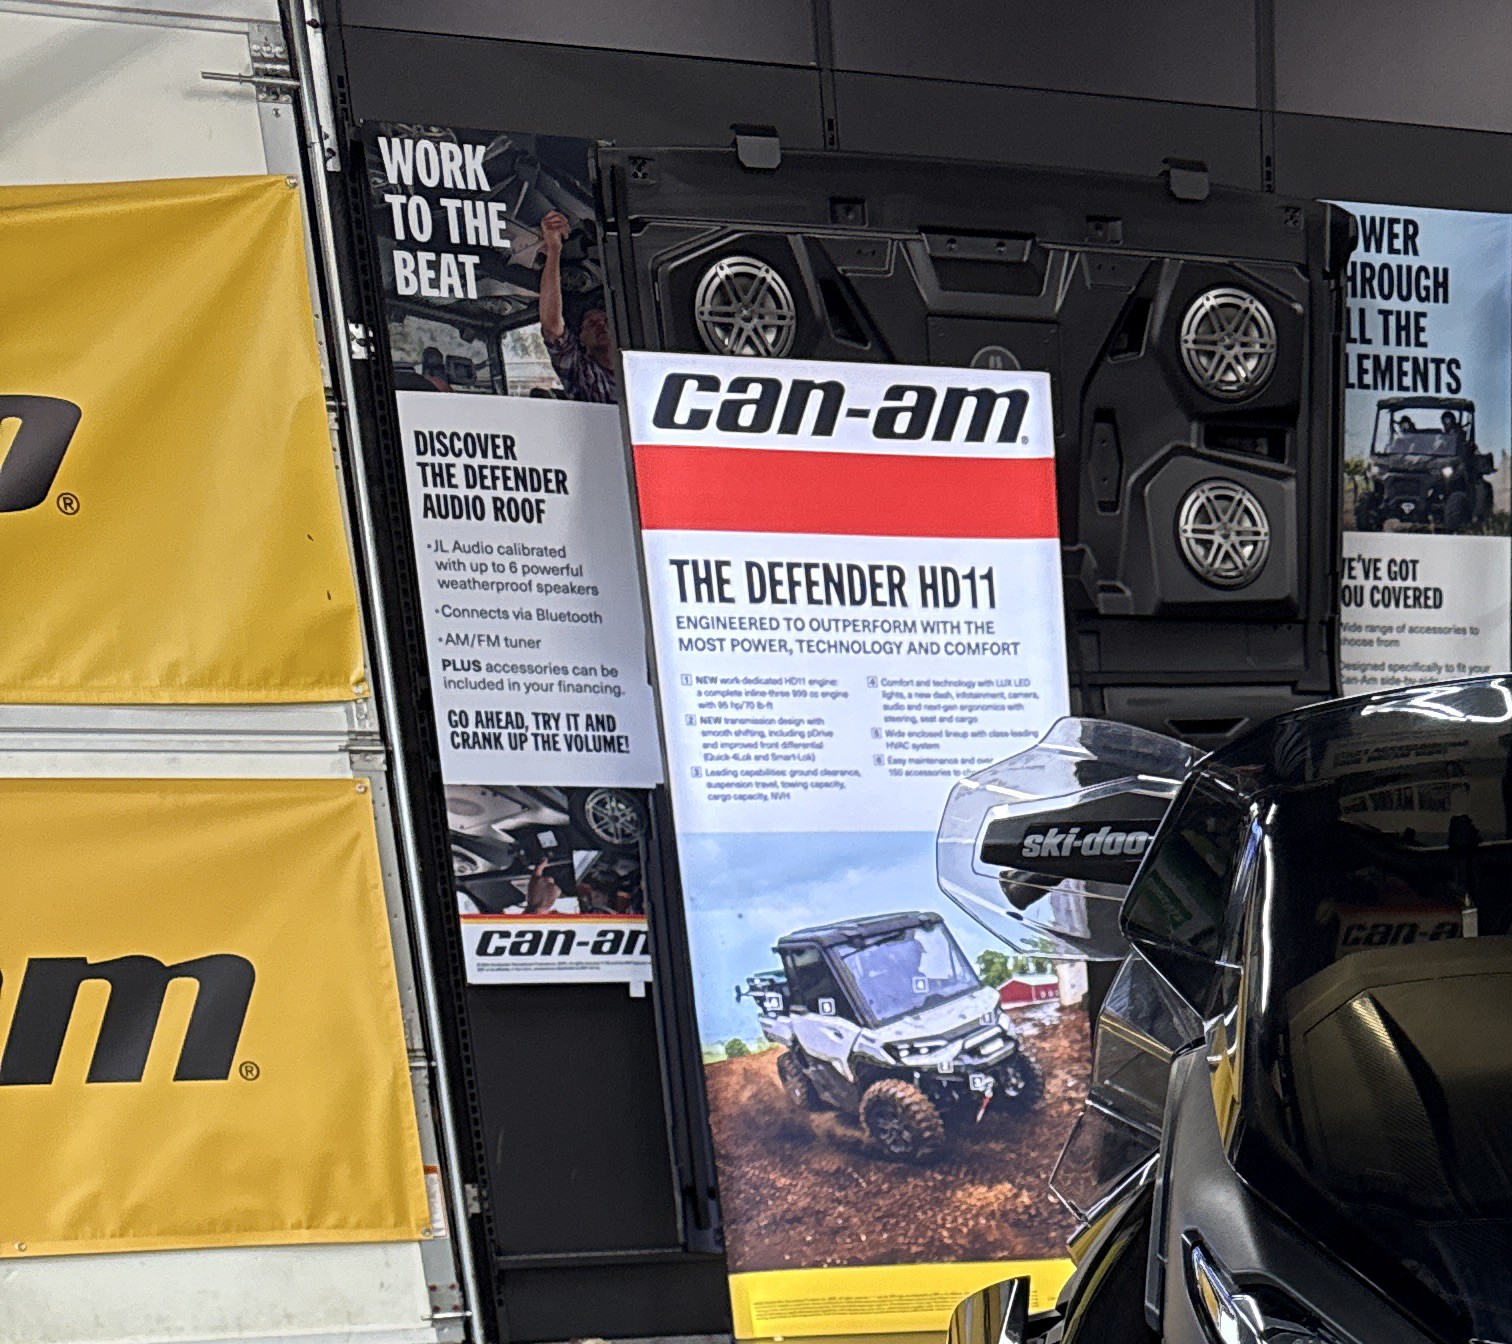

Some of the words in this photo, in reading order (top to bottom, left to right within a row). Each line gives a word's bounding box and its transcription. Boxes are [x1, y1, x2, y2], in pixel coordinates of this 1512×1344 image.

[377, 136, 491, 192] WORK
[384, 194, 433, 243] TO
[440, 198, 511, 248] THE
[1350, 214, 1419, 256] WER
[393, 250, 480, 300] BEAT
[1347, 260, 1449, 304] HROUGH
[1346, 306, 1372, 345] LL
[1378, 308, 1428, 348] THE
[1345, 352, 1462, 395] LEMENTS
[652, 372, 1030, 444] can-am
[413, 430, 517, 461] DISCOVER
[416, 462, 459, 489] THE
[463, 464, 569, 495] DEFENDER
[423, 493, 486, 521] AUDIO
[492, 496, 546, 524] ROOF
[452, 540, 494, 555] Audio
[496, 543, 566, 558] calibrated
[435, 559, 466, 573] with
[470, 562, 488, 576] up
[492, 562, 506, 574] to
[509, 562, 518, 574] 6
[522, 563, 583, 578] powerful
[1387, 558, 1419, 582] GOT
[437, 578, 533, 594] weatherproof
[536, 582, 600, 596] speakers
[669, 559, 735, 604] THE
[746, 560, 908, 607] DEFENDER
[919, 564, 997, 609] HD11
[1342, 584, 1364, 608] OU
[1370, 585, 1443, 609] COVERED
[441, 605, 510, 620] Connects
[512, 608, 533, 621] via
[536, 608, 603, 625] Bluetooth
[676, 616, 779, 632] ENGINEERED
[783, 617, 805, 632] TO
[809, 618, 917, 634] OUTPERFORM
[921, 620, 961, 635] WITH
[965, 621, 996, 635] THE
[445, 633, 500, 649] AM/FM
[504, 636, 542, 649] tuner
[1408, 624, 1467, 635] accessories
[678, 638, 726, 653] MOST
[730, 638, 793, 654] POWER,
[797, 639, 902, 656] TECHNOLOGY
[907, 640, 940, 656] AND
[944, 641, 1021, 656] COMFORT
[441, 658, 482, 673] PLUS
[486, 661, 569, 676] accessories
[572, 665, 598, 677] can
[600, 663, 619, 678] be
[444, 676, 504, 691] included
[508, 677, 521, 691] in
[523, 680, 553, 695] your
[558, 679, 626, 697] financing.
[448, 709, 469, 730] GO
[474, 710, 530, 733] AHEAD,
[531, 712, 561, 732] TRY
[566, 713, 581, 732] IT
[585, 714, 617, 733] AND
[450, 731, 504, 751] CRANK
[508, 732, 528, 751] UP
[531, 733, 561, 752] THE
[563, 734, 630, 754] VOLUME!
[1022, 826, 1150, 858] ski-doo
[1341, 920, 1461, 947] can-a
